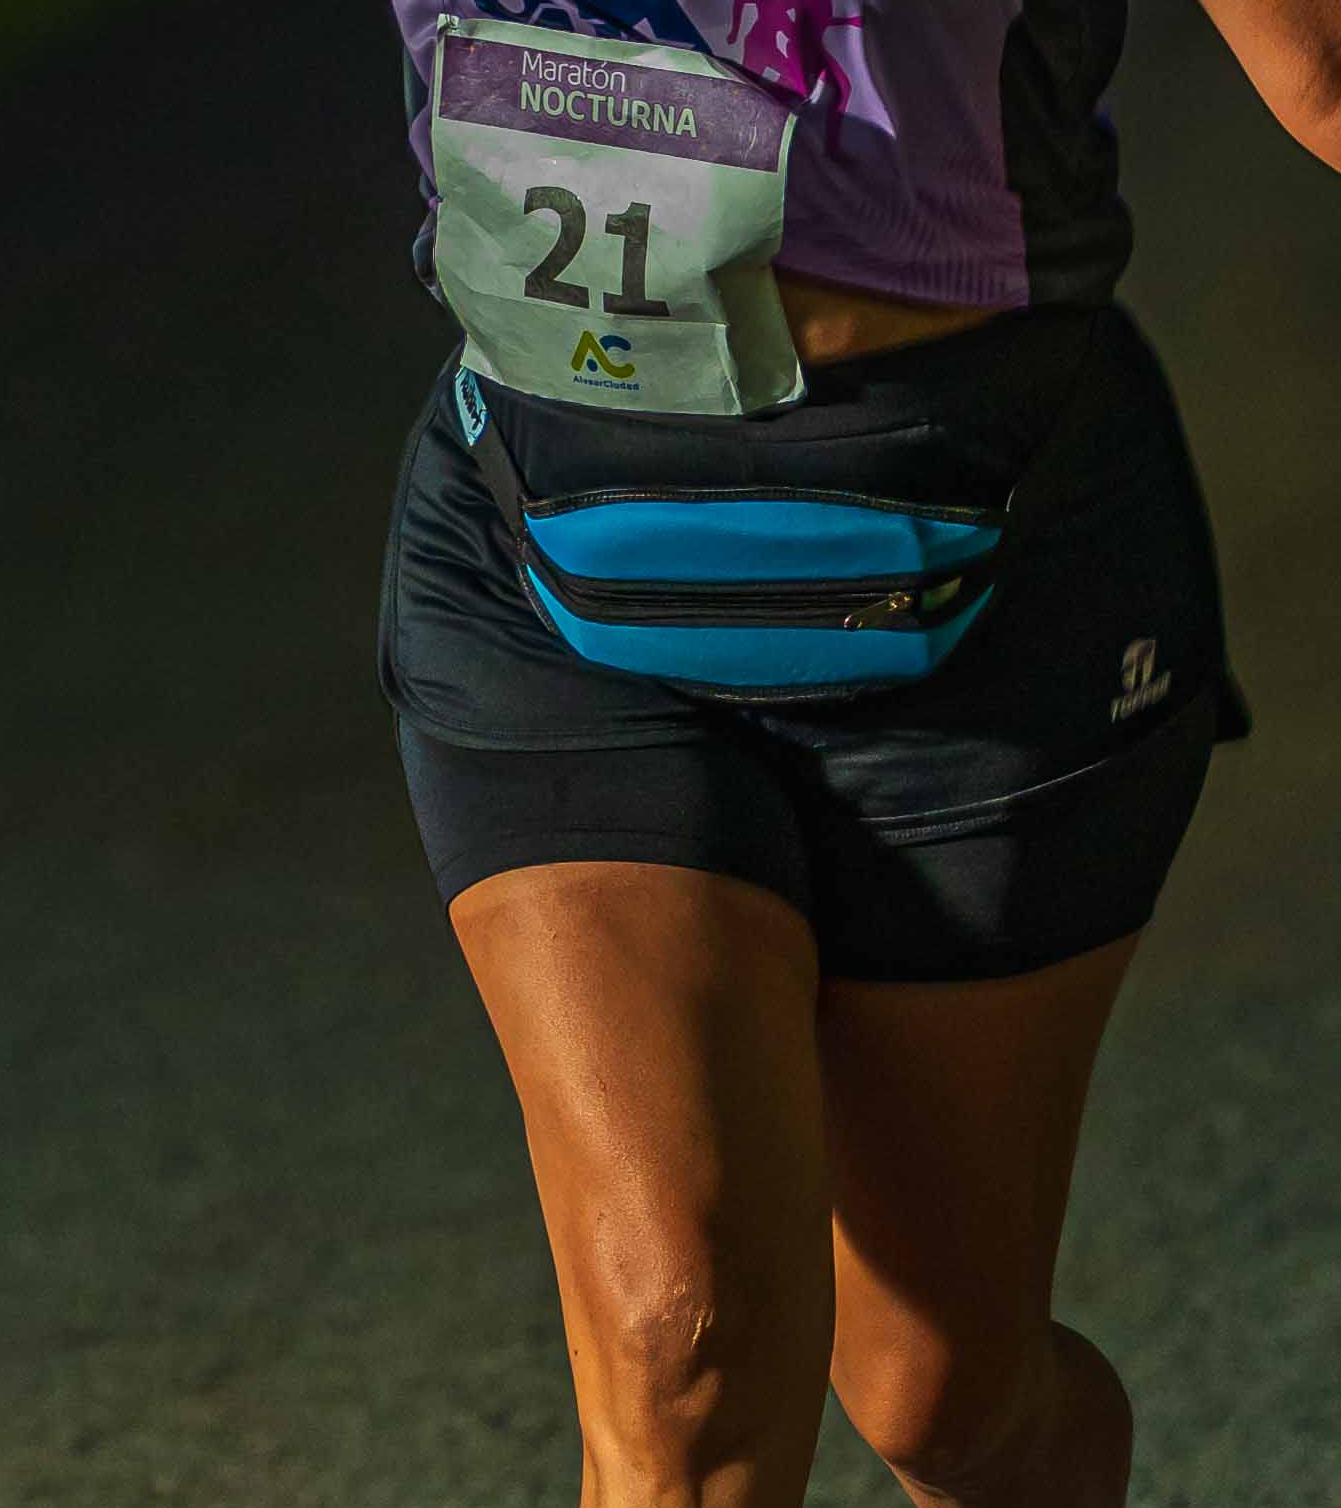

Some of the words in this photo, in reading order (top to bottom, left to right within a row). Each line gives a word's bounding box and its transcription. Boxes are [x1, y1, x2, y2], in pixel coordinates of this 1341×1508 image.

[520, 50, 626, 93] Maratón
[520, 80, 699, 139] NOCTURNA
[522, 185, 671, 317] 21
